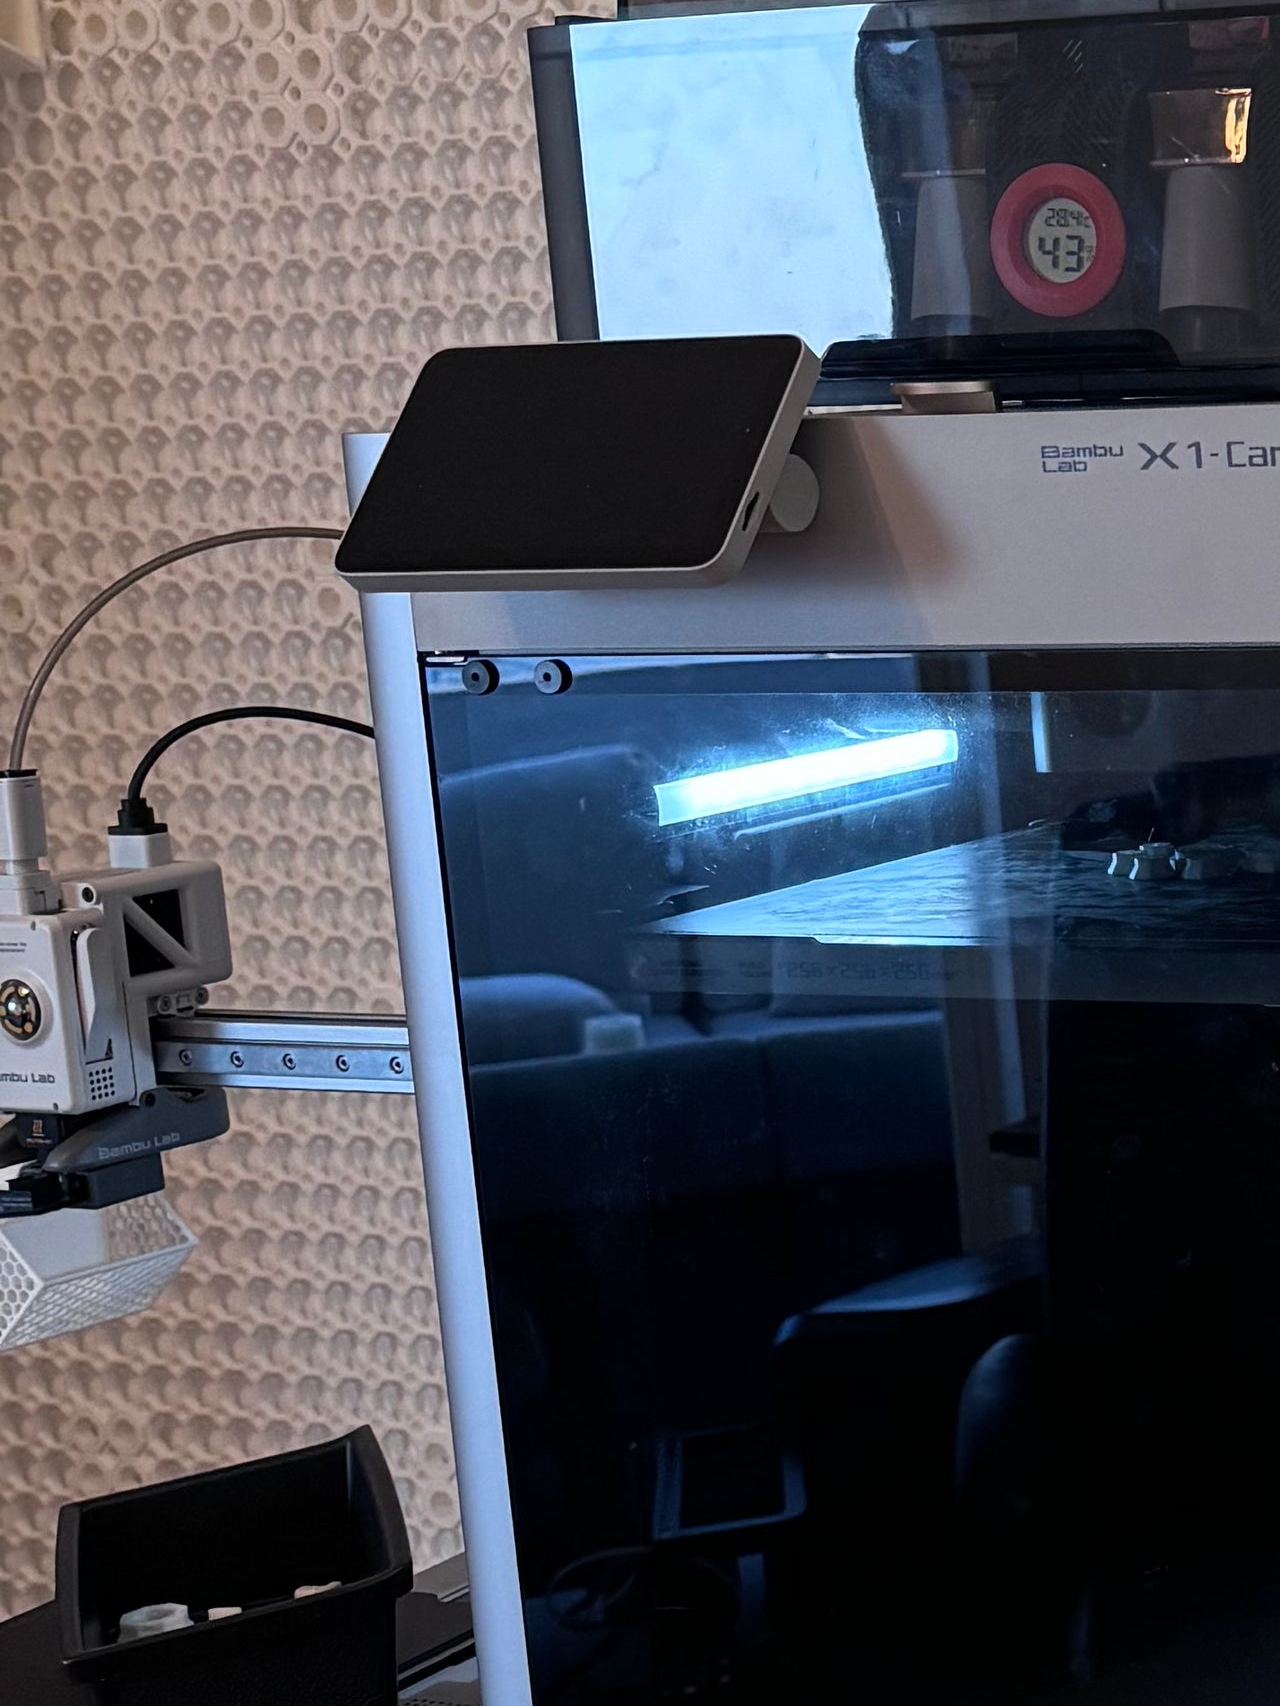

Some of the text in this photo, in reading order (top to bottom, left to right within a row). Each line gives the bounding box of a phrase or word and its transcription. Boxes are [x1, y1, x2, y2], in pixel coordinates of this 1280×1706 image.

[1038, 235, 1085, 272] 43
[1041, 444, 1124, 459] Bambu
[1043, 459, 1087, 473] Lab
[31, 1073, 56, 1084] Lab
[98, 1131, 181, 1160] Bambu Lab
